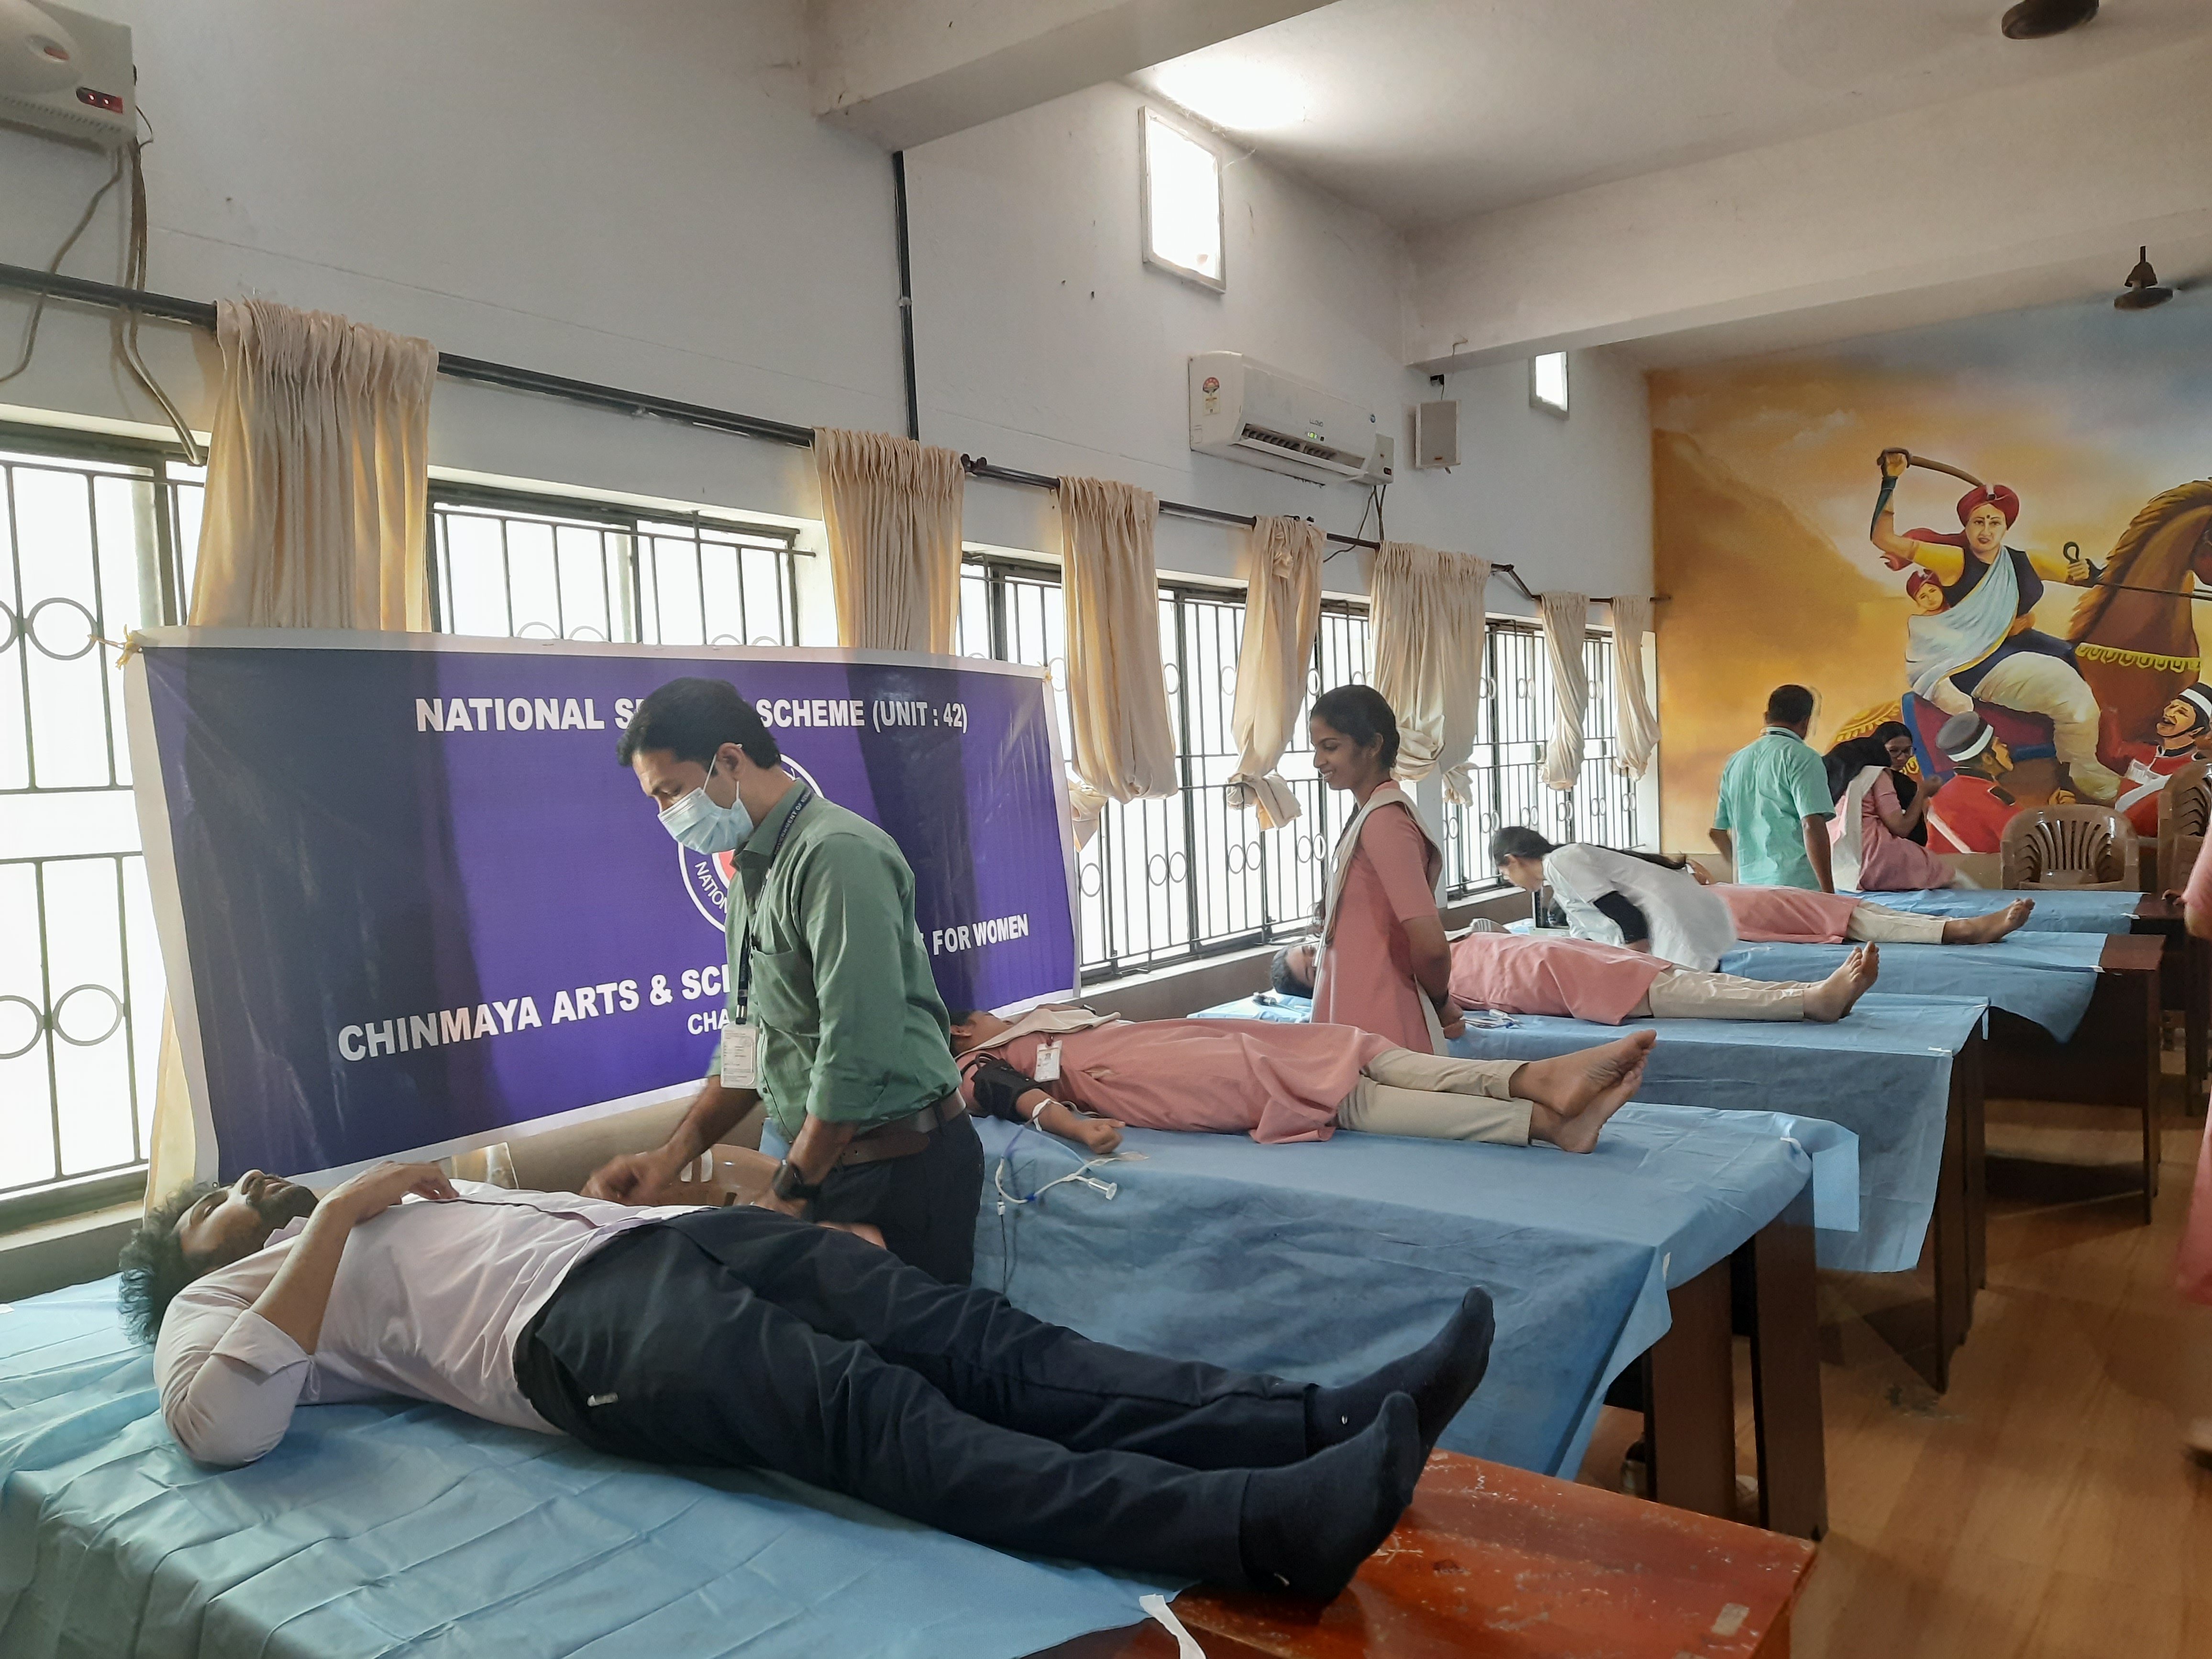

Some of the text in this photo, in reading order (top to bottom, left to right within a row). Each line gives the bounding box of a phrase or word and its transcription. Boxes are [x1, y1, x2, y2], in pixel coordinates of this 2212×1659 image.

[415, 697, 605, 732] NATIONAL
[755, 699, 865, 728] SCHEME
[873, 700, 928, 733] (UNIT
[943, 702, 968, 734] 42)
[694, 861, 728, 914] NATION
[338, 996, 542, 1062] CHINMAYA
[551, 979, 640, 1025] ARTS
[649, 974, 674, 1006] &
[681, 963, 731, 1000] SCI
[932, 925, 972, 955] FOR
[972, 913, 1029, 947] WOMEN
[687, 1008, 731, 1035] CHA
